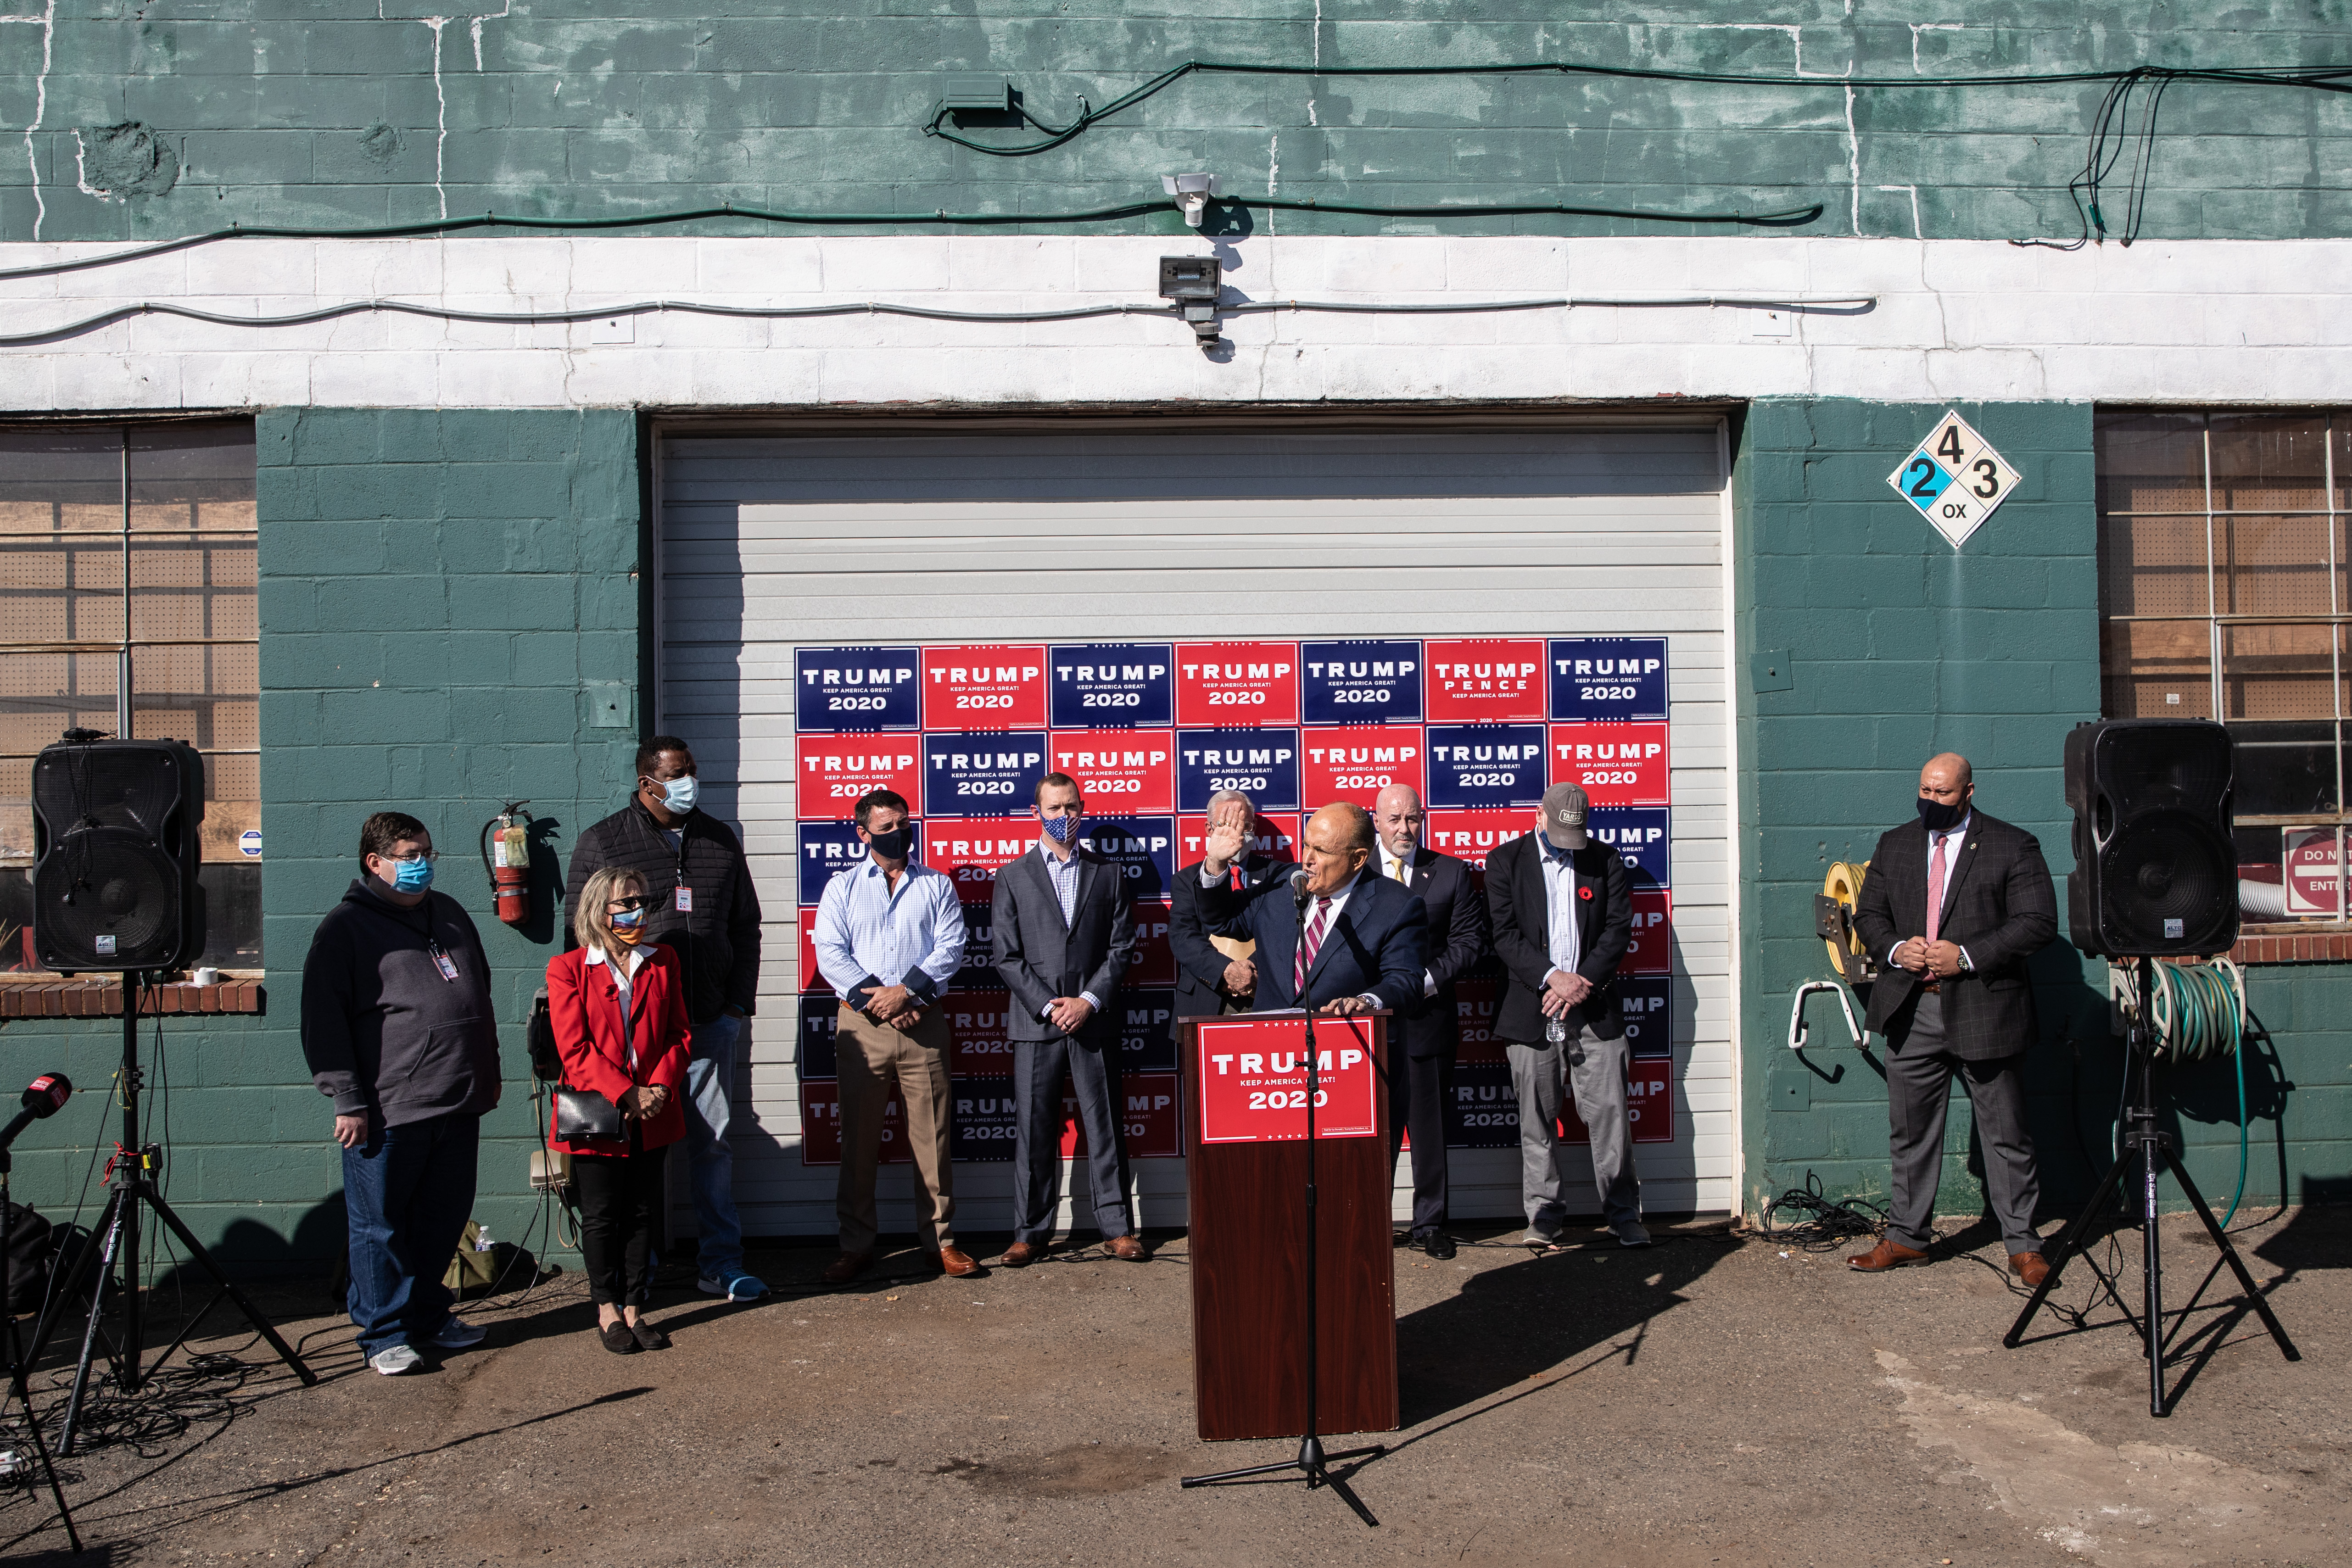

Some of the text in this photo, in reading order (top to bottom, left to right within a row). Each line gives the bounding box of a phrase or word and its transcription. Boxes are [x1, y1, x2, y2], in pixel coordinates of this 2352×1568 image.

[1938, 425, 1964, 464] 4
[1910, 458, 1937, 497] 2
[1973, 459, 1999, 498] 3
[1943, 504, 1967, 519] OX
[930, 666, 1039, 683] TRUMP
[1056, 665, 1165, 681] TRUMP
[1183, 663, 1291, 679] TRUMP
[1308, 661, 1415, 678] TRUMP
[1435, 663, 1536, 678] TRUMP
[1555, 659, 1660, 675] TRUMP
[803, 668, 912, 685] TRUMP
[1445, 680, 1527, 691] PENCE
[1581, 686, 1636, 700] 2020
[829, 697, 887, 710] 2020
[956, 695, 1014, 709] 2020
[1083, 693, 1140, 707] 2020
[1208, 691, 1266, 705] 2020
[1334, 689, 1391, 703] 2020
[1184, 749, 1291, 765] TRUMP
[1309, 747, 1416, 764] TRUMP
[1433, 745, 1539, 761] TRUMP
[1556, 743, 1661, 759] TRUMP
[804, 755, 913, 771] TRUMP
[931, 753, 1040, 769] TRUMP
[1057, 751, 1166, 768] TRUMP
[1210, 777, 1267, 791] 2020
[1335, 775, 1391, 789] 2020
[1459, 773, 1515, 787] 2020
[1582, 771, 1637, 785] 2020
[957, 781, 1015, 795] 2020
[1084, 779, 1141, 793] 2020
[1563, 812, 1581, 820] YARDS
[1185, 835, 1293, 852] TMP
[1435, 830, 1531, 847] TRUM
[1586, 828, 1662, 844] UMP
[1079, 837, 1168, 853] RUMP
[2304, 850, 2352, 860] DO NT
[958, 868, 996, 881] 202
[961, 954, 996, 967] 202
[1462, 1029, 1503, 1042] 202
[1212, 1049, 1363, 1075] TRUMP
[952, 1099, 1017, 1114] RUM
[1249, 1089, 1328, 1110] 2020
[1463, 1113, 1519, 1126] 2020
[963, 1127, 1017, 1139] 2020
